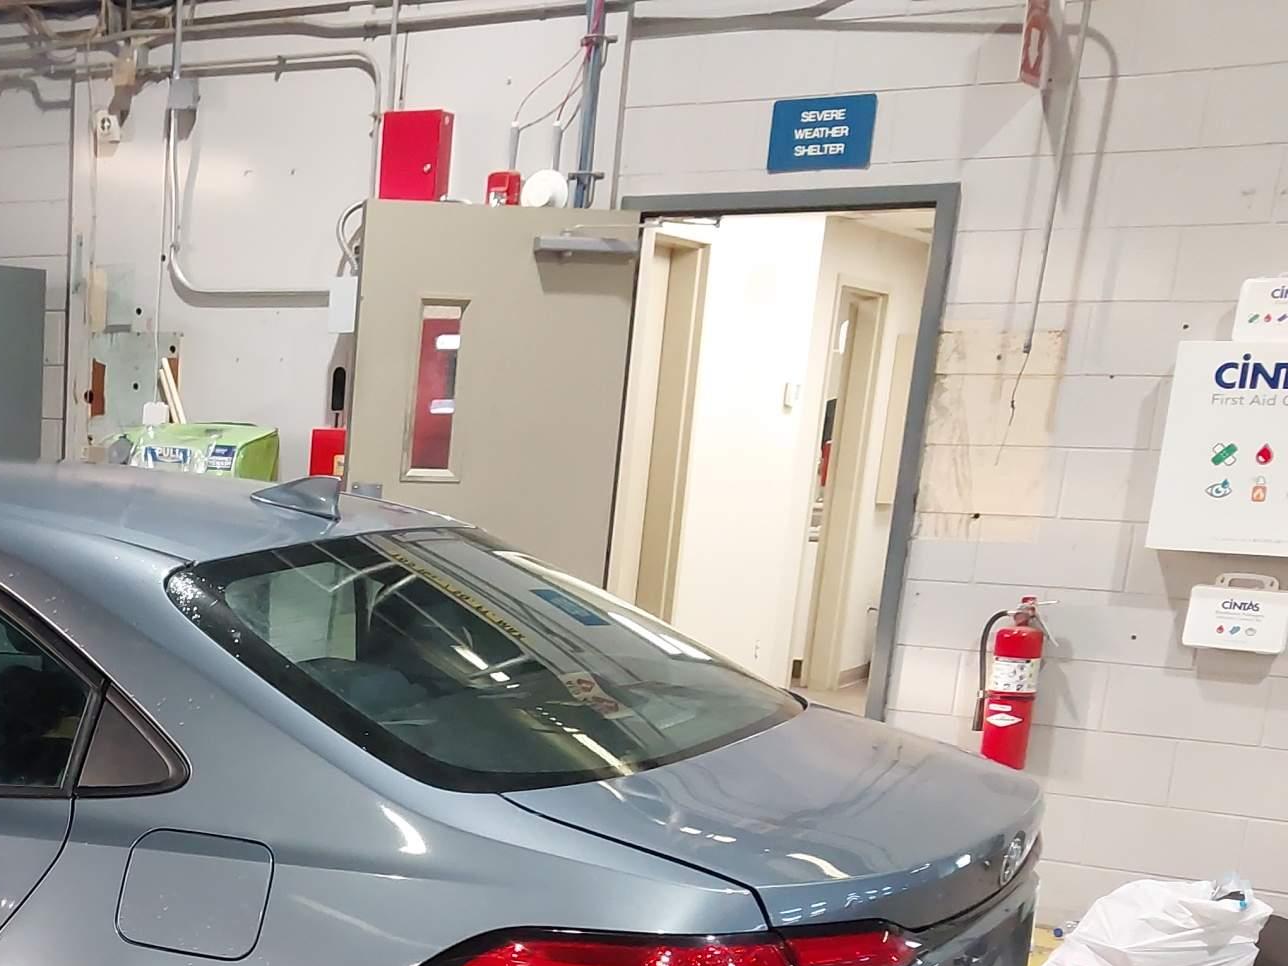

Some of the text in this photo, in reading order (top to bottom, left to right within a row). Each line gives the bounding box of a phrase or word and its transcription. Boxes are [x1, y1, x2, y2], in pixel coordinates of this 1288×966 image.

[800, 109, 847, 122] SEVERE
[794, 126, 849, 139] WEATHER
[794, 143, 845, 156] SHELTER
[1211, 393, 1245, 406] First
[1249, 394, 1277, 406] Aid
[157, 446, 180, 459] PULL
